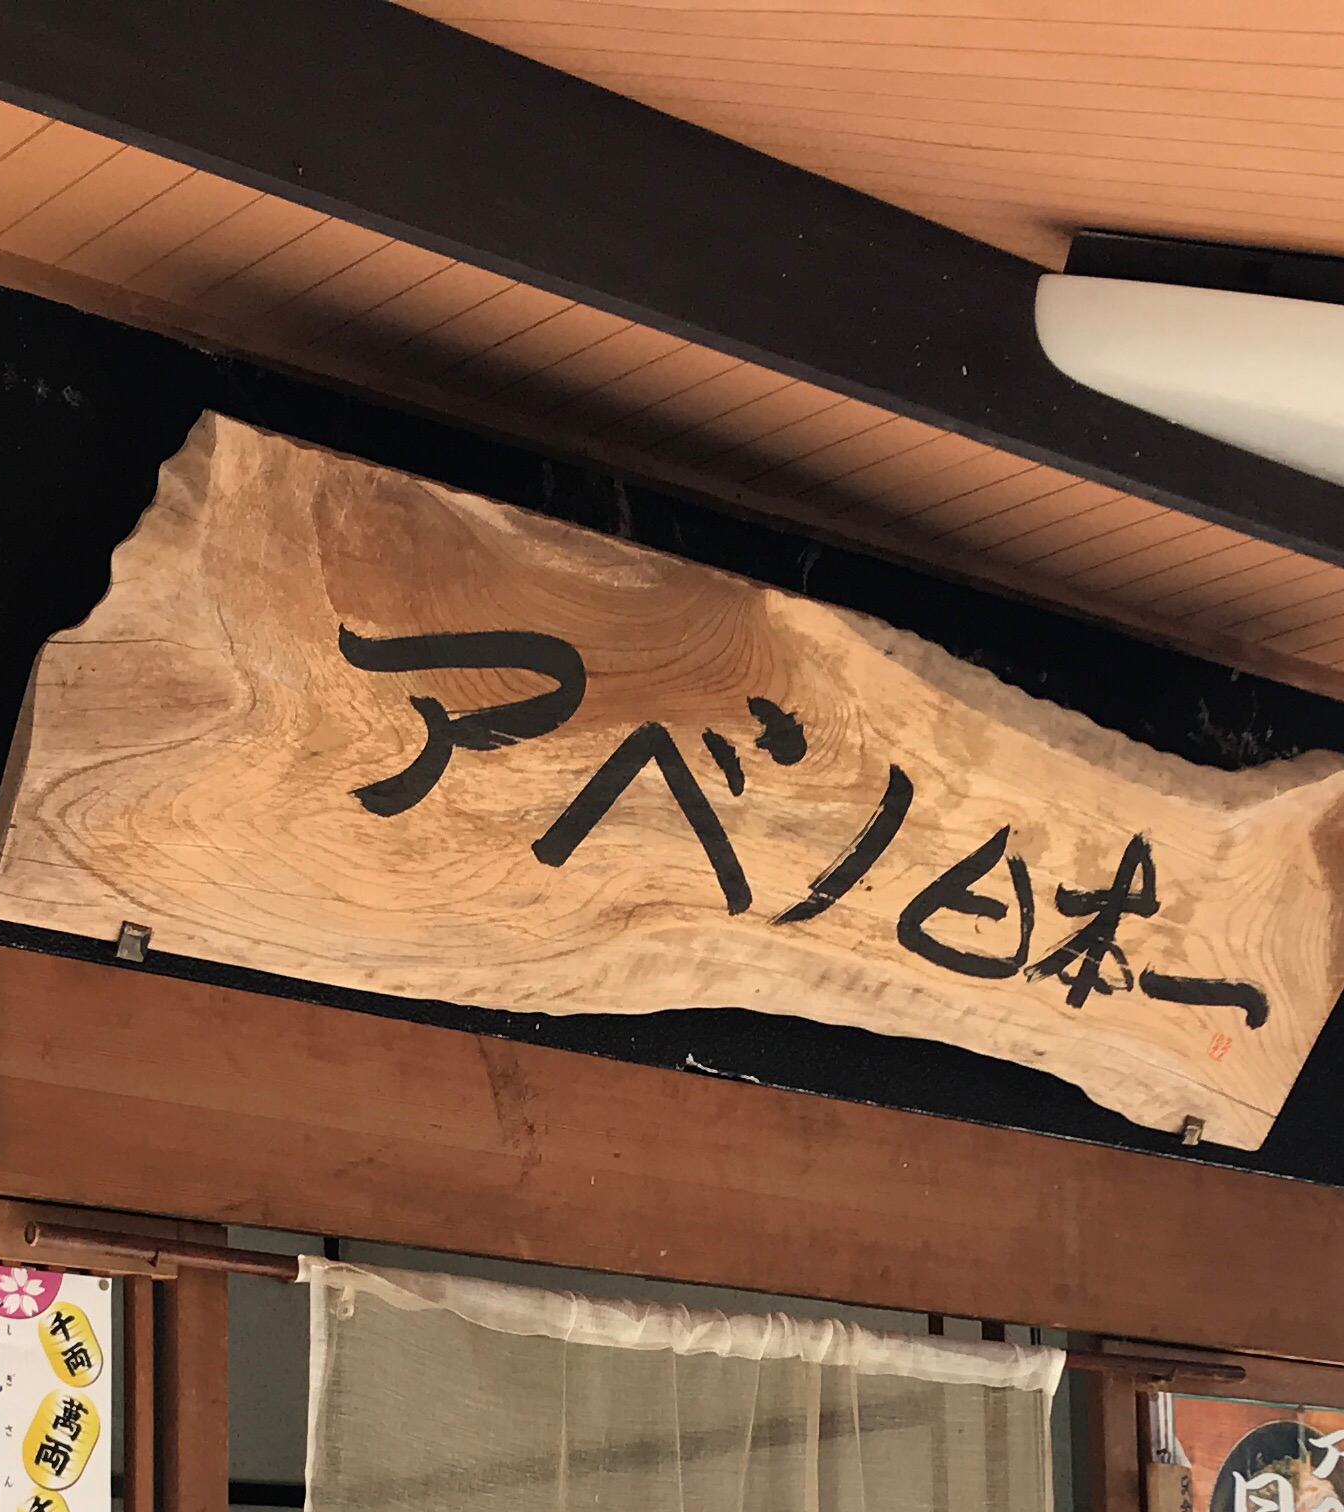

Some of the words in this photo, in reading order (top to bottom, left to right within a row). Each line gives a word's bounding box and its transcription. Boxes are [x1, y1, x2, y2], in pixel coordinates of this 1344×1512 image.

[338, 622, 1270, 1031] アベノ日本一
[50, 1310, 93, 1377] 千両
[4, 1323, 15, 1489] しぎさん
[34, 1397, 88, 1478] 萬両
